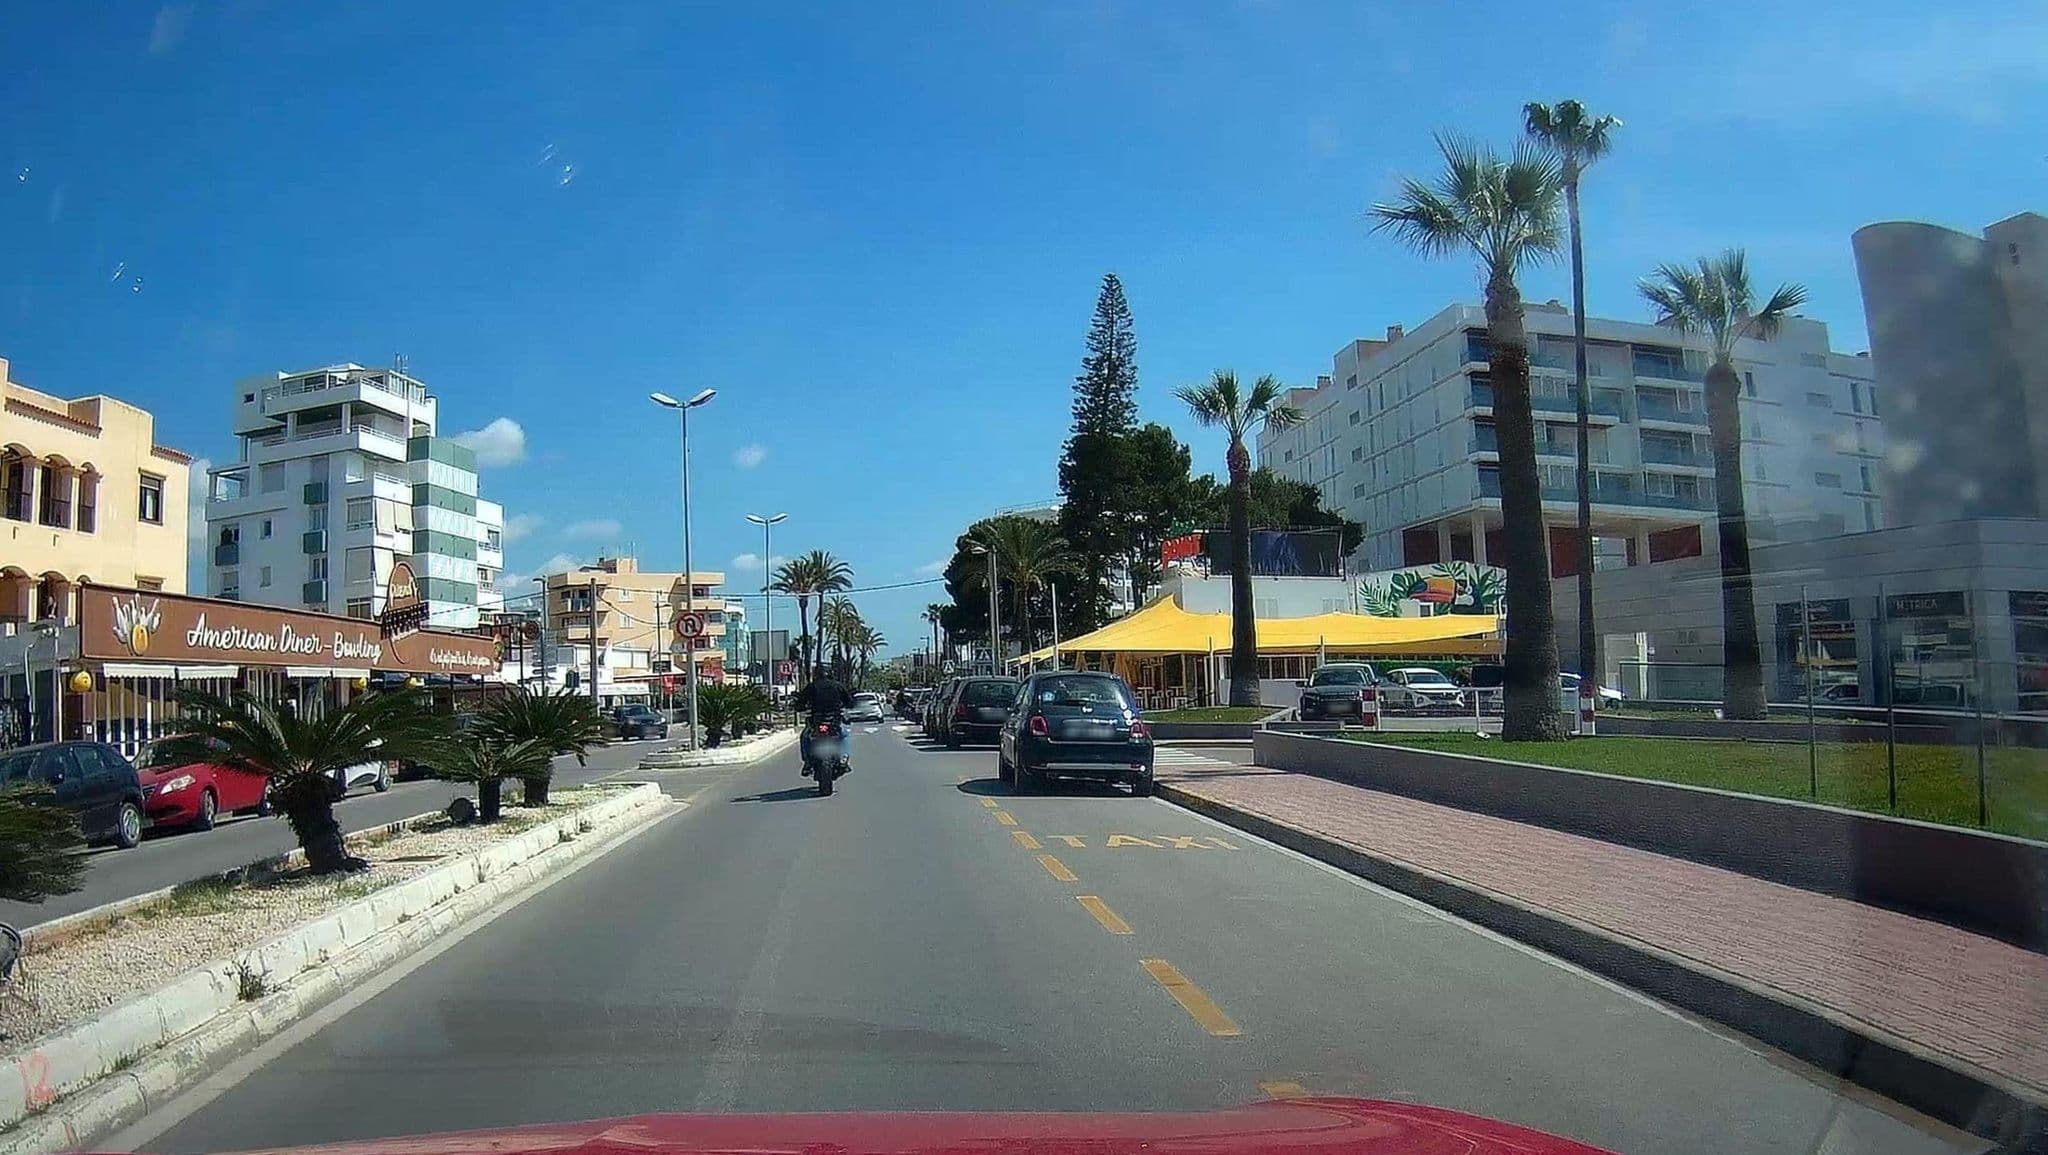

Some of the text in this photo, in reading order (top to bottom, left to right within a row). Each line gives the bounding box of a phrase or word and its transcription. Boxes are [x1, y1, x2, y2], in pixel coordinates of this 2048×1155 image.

[187, 612, 278, 650] American
[280, 623, 322, 654] Diner
[333, 632, 383, 665] Bowling
[1047, 834, 1241, 850] TAXI
